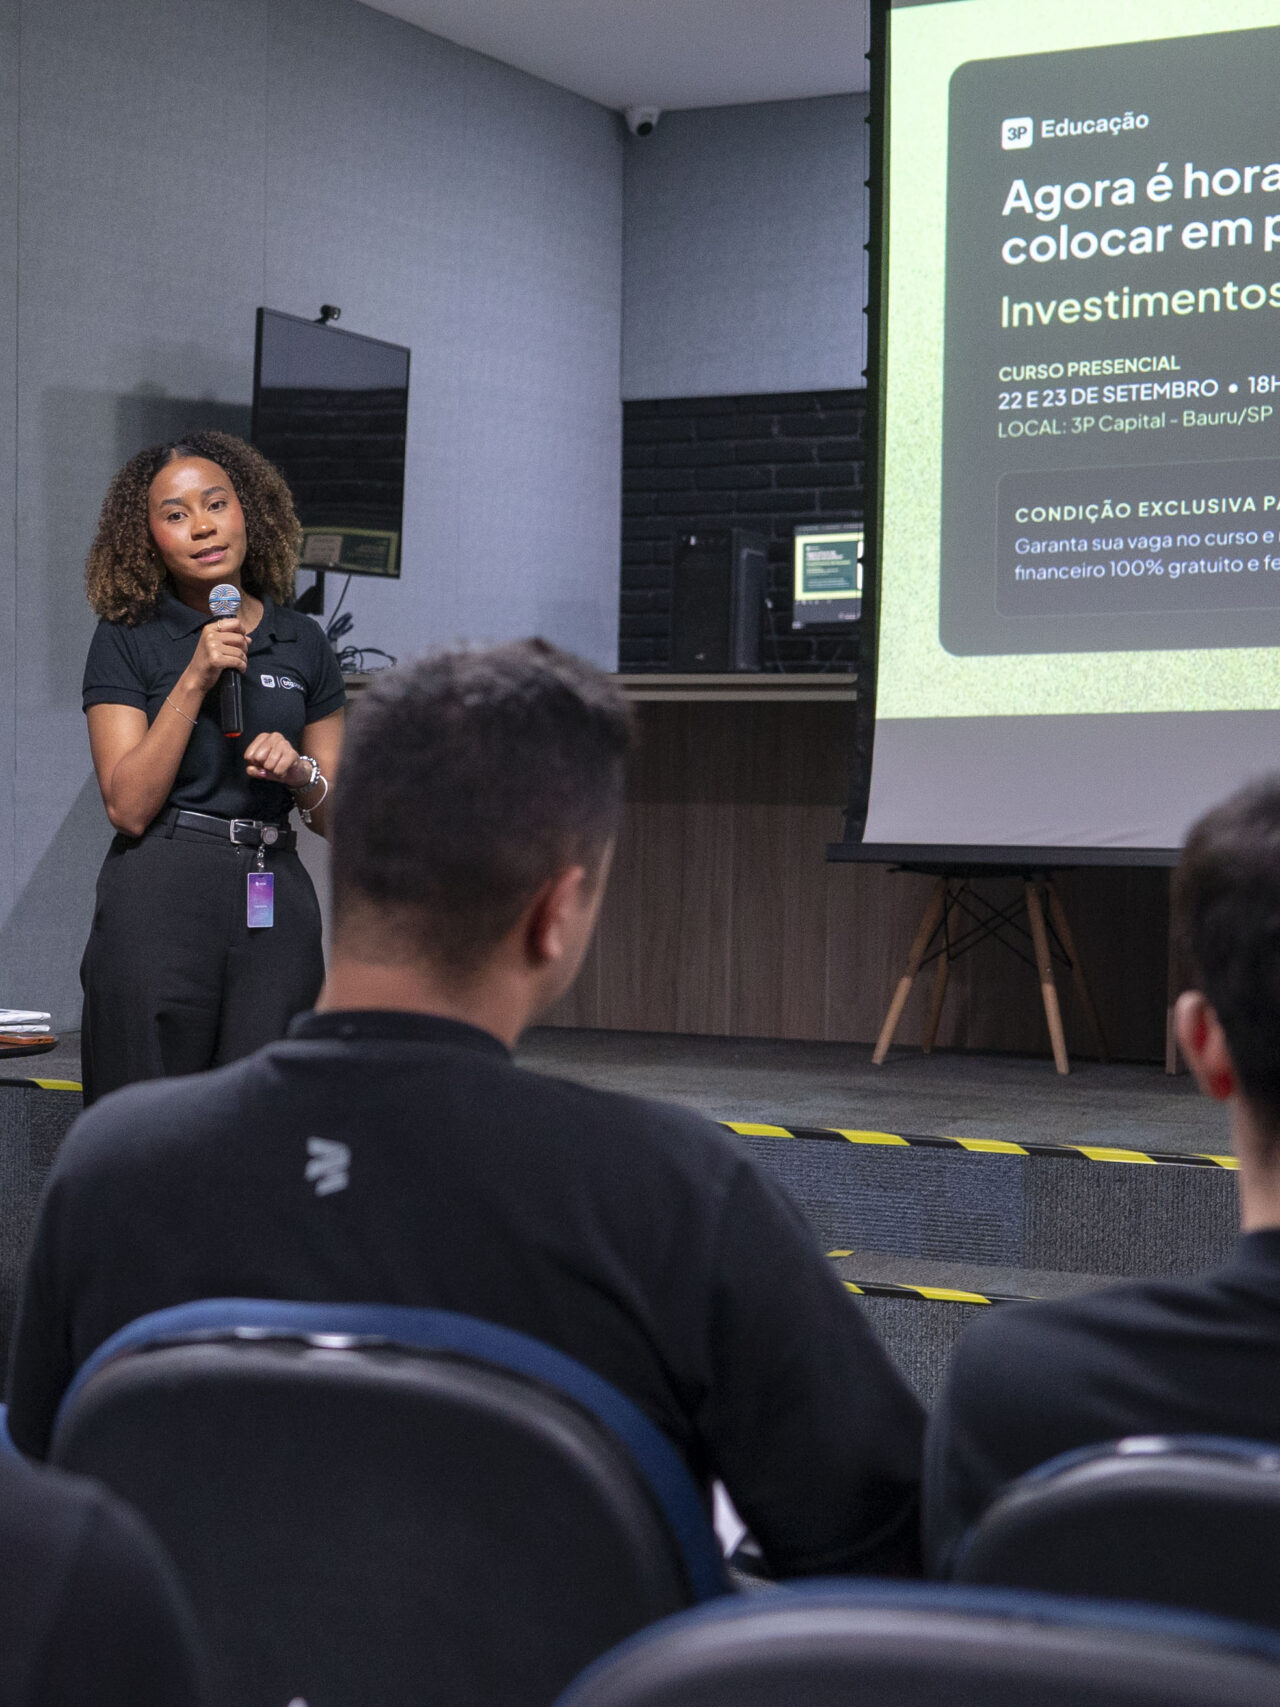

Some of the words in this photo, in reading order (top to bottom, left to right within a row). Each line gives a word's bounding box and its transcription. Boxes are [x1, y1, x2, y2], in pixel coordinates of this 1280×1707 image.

[1008, 126, 1027, 140] 3P
[1042, 112, 1149, 138] Educação
[1002, 178, 1135, 221] Agora
[1147, 163, 1173, 202] é
[1185, 163, 1280, 199] hora
[1002, 225, 1172, 264] colocar
[1182, 218, 1252, 249] em
[999, 363, 1064, 381] CURSO
[1068, 356, 1180, 377] PRESENCIAL
[999, 392, 1022, 409] 22
[1027, 391, 1038, 408] E
[1043, 389, 1066, 407] 23
[1072, 387, 1098, 405] DE
[1103, 379, 1218, 403] SETEMBRO
[999, 419, 1067, 438] LOCAL:
[1072, 417, 1095, 433] 3P
[1099, 412, 1165, 433] Capital
[1183, 406, 1273, 426] Bauru/SP
[1016, 500, 1131, 523] CONDIÇÃO
[1139, 497, 1256, 517] EXCLUSIVA
[1264, 496, 1280, 510] P
[1015, 538, 1087, 554] Garanta
[1092, 538, 1123, 550] sua
[1128, 536, 1172, 552] vaga
[1177, 534, 1200, 546] no
[1205, 532, 1258, 546] curso
[1263, 531, 1274, 543] e
[1015, 562, 1105, 580] financeiro
[1110, 560, 1164, 577] 100%
[1168, 559, 1243, 578] gratuito
[1248, 559, 1259, 571] e
